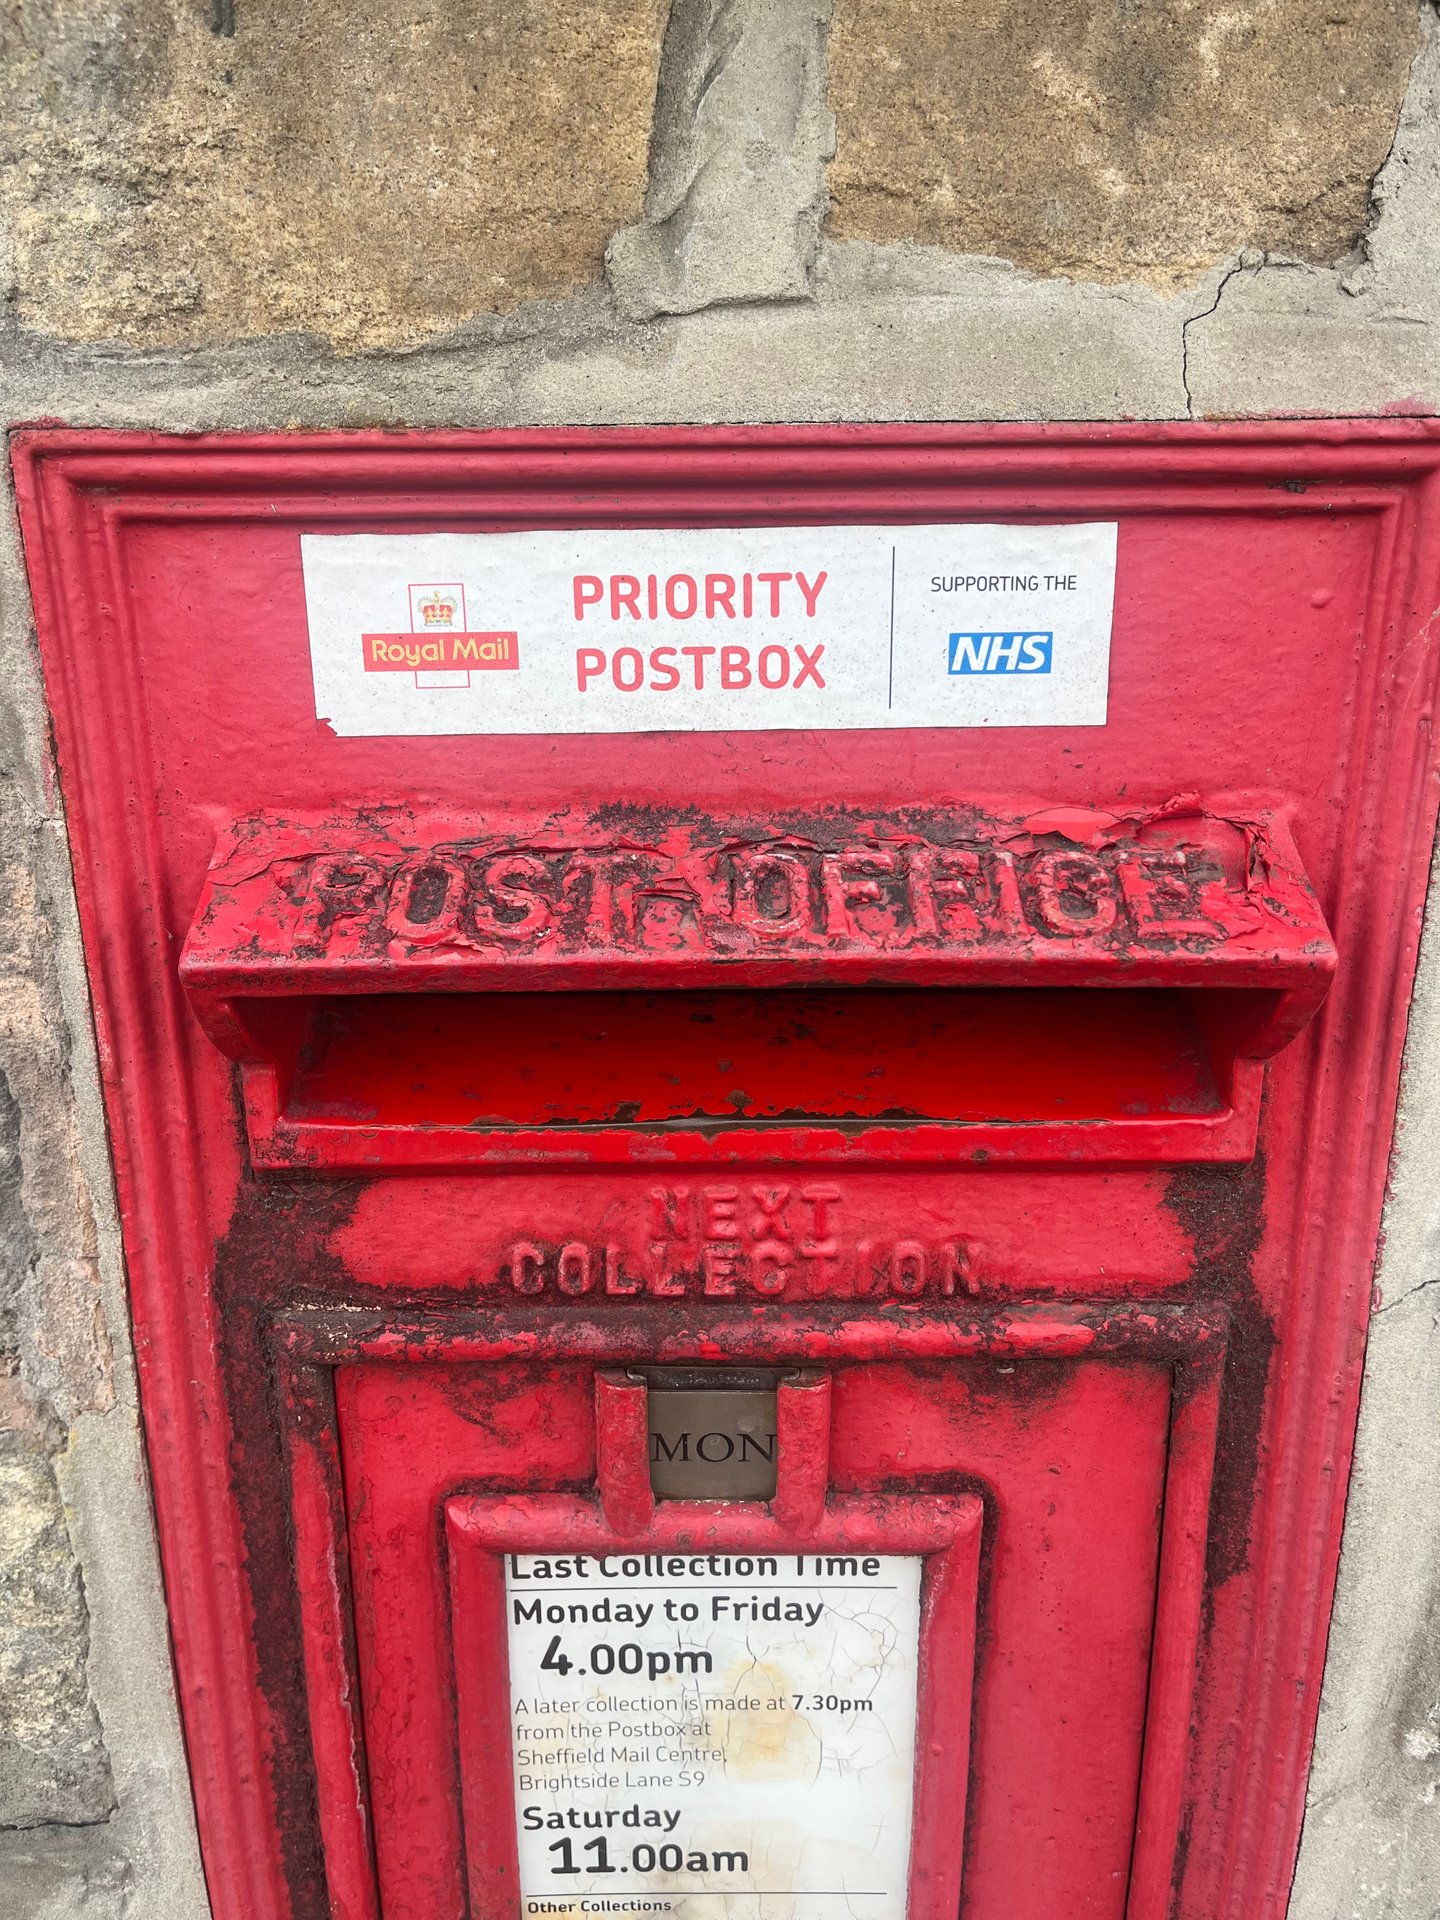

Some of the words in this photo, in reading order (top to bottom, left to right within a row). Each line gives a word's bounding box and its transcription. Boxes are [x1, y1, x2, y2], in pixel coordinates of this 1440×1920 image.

[573, 571, 828, 621] PRIORITY
[931, 576, 1038, 592] SUPPORTING
[1044, 575, 1077, 590] THE
[371, 639, 444, 666] Royal
[453, 638, 509, 660] Mail
[953, 636, 1048, 671] NHS
[576, 644, 826, 692] POSTBOX
[294, 853, 645, 949] POST
[732, 848, 1228, 944] OFFICE
[650, 1184, 842, 1240] NEXT
[511, 1240, 981, 1296] COLLECTION
[651, 1432, 777, 1463] MON
[511, 1555, 589, 1580] Last
[600, 1555, 777, 1578] Collection
[514, 1600, 653, 1628] Monday
[664, 1600, 699, 1621] to
[712, 1596, 824, 1627] Friday
[540, 1636, 712, 1681] 4.00pm
[515, 1701, 528, 1715] A
[534, 1698, 577, 1713] later
[586, 1696, 677, 1712] collection
[685, 1696, 698, 1711] is
[705, 1696, 761, 1711] made
[767, 1697, 786, 1710] at
[792, 1695, 873, 1715] 7.30pm
[517, 1724, 564, 1740] from
[570, 1723, 602, 1738] the
[609, 1722, 686, 1737] Postbox
[692, 1722, 710, 1736] at
[518, 1748, 604, 1766] Sheffield
[611, 1746, 650, 1763] Mail
[520, 1773, 619, 1792] Brightside
[625, 1773, 672, 1788] Lane
[679, 1771, 705, 1787] S9
[523, 1804, 681, 1832] Saturday
[548, 1836, 748, 1874] 11.00am
[528, 1900, 576, 1914] Other
[581, 1898, 671, 1913] Collections
